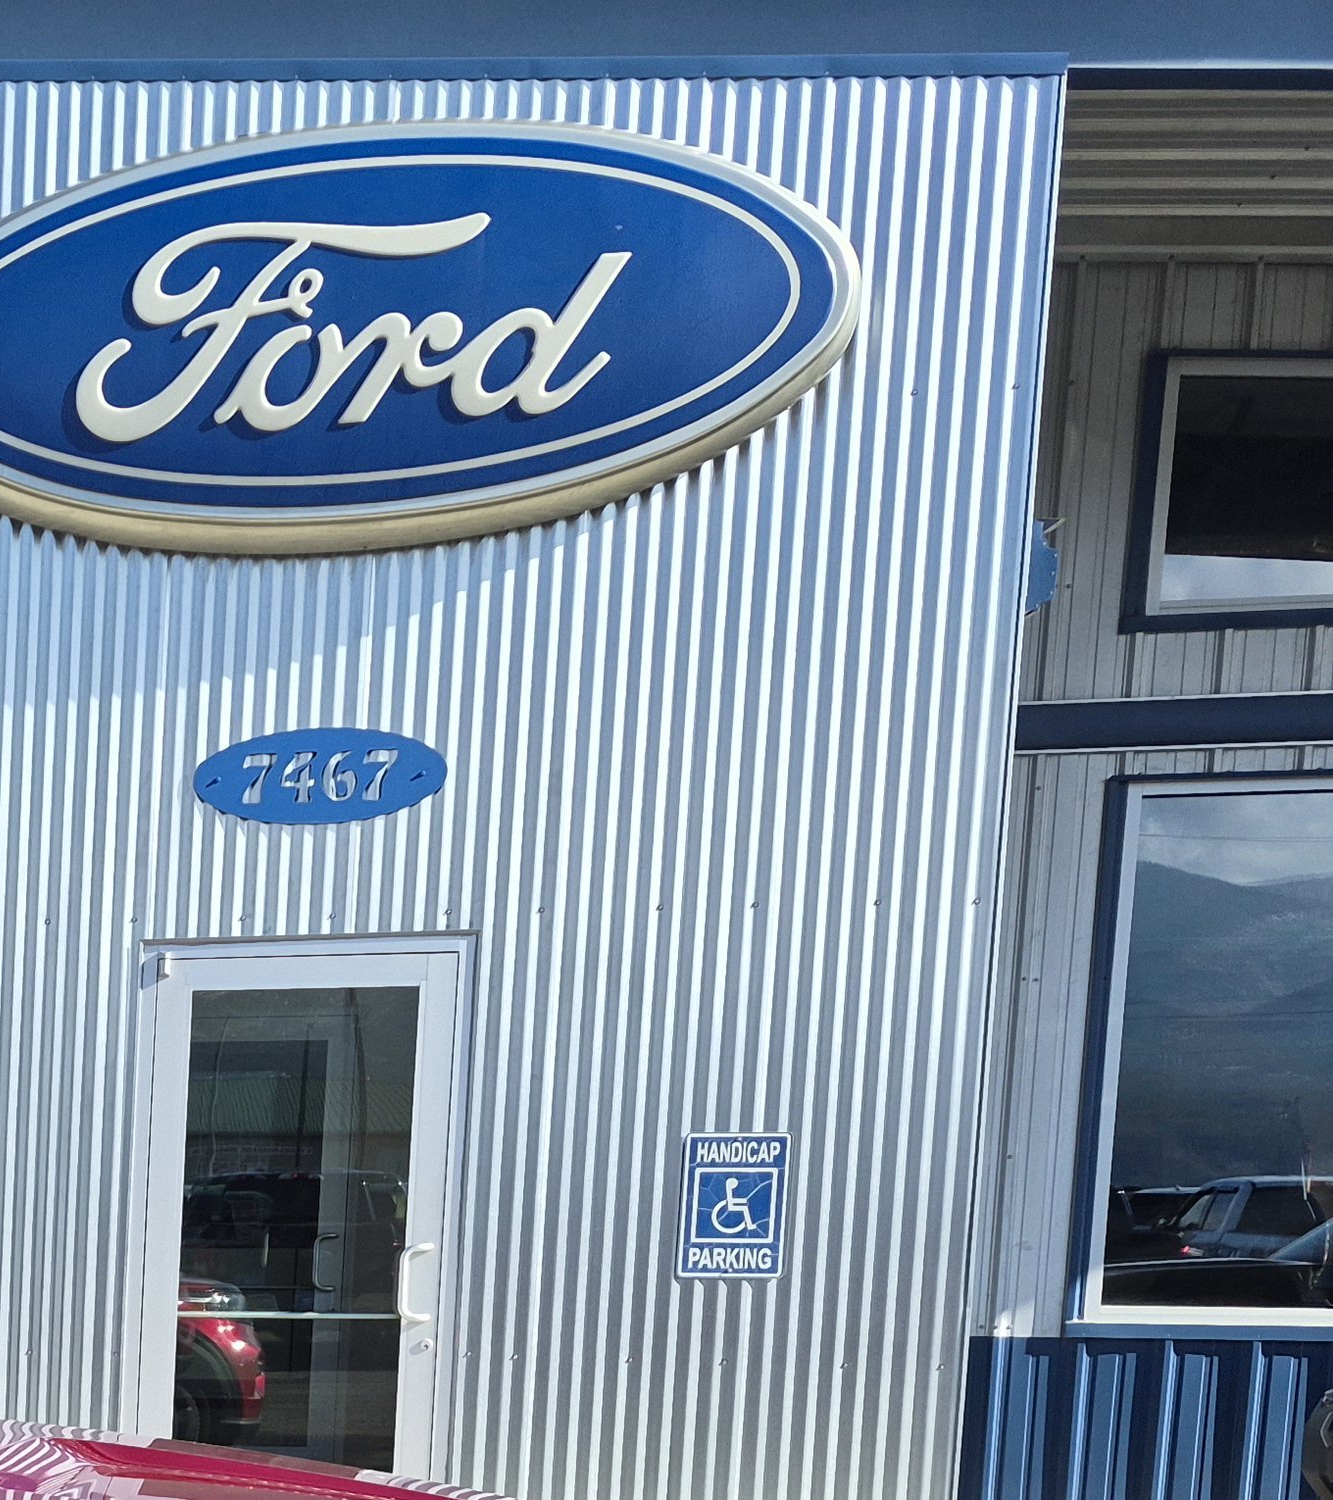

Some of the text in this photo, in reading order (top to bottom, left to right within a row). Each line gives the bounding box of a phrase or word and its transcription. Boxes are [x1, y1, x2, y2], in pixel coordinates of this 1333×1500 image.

[76, 212, 632, 443] Ford
[241, 748, 399, 805] 7467
[697, 1141, 781, 1164] HANDICAP
[687, 1247, 773, 1270] PARKING
